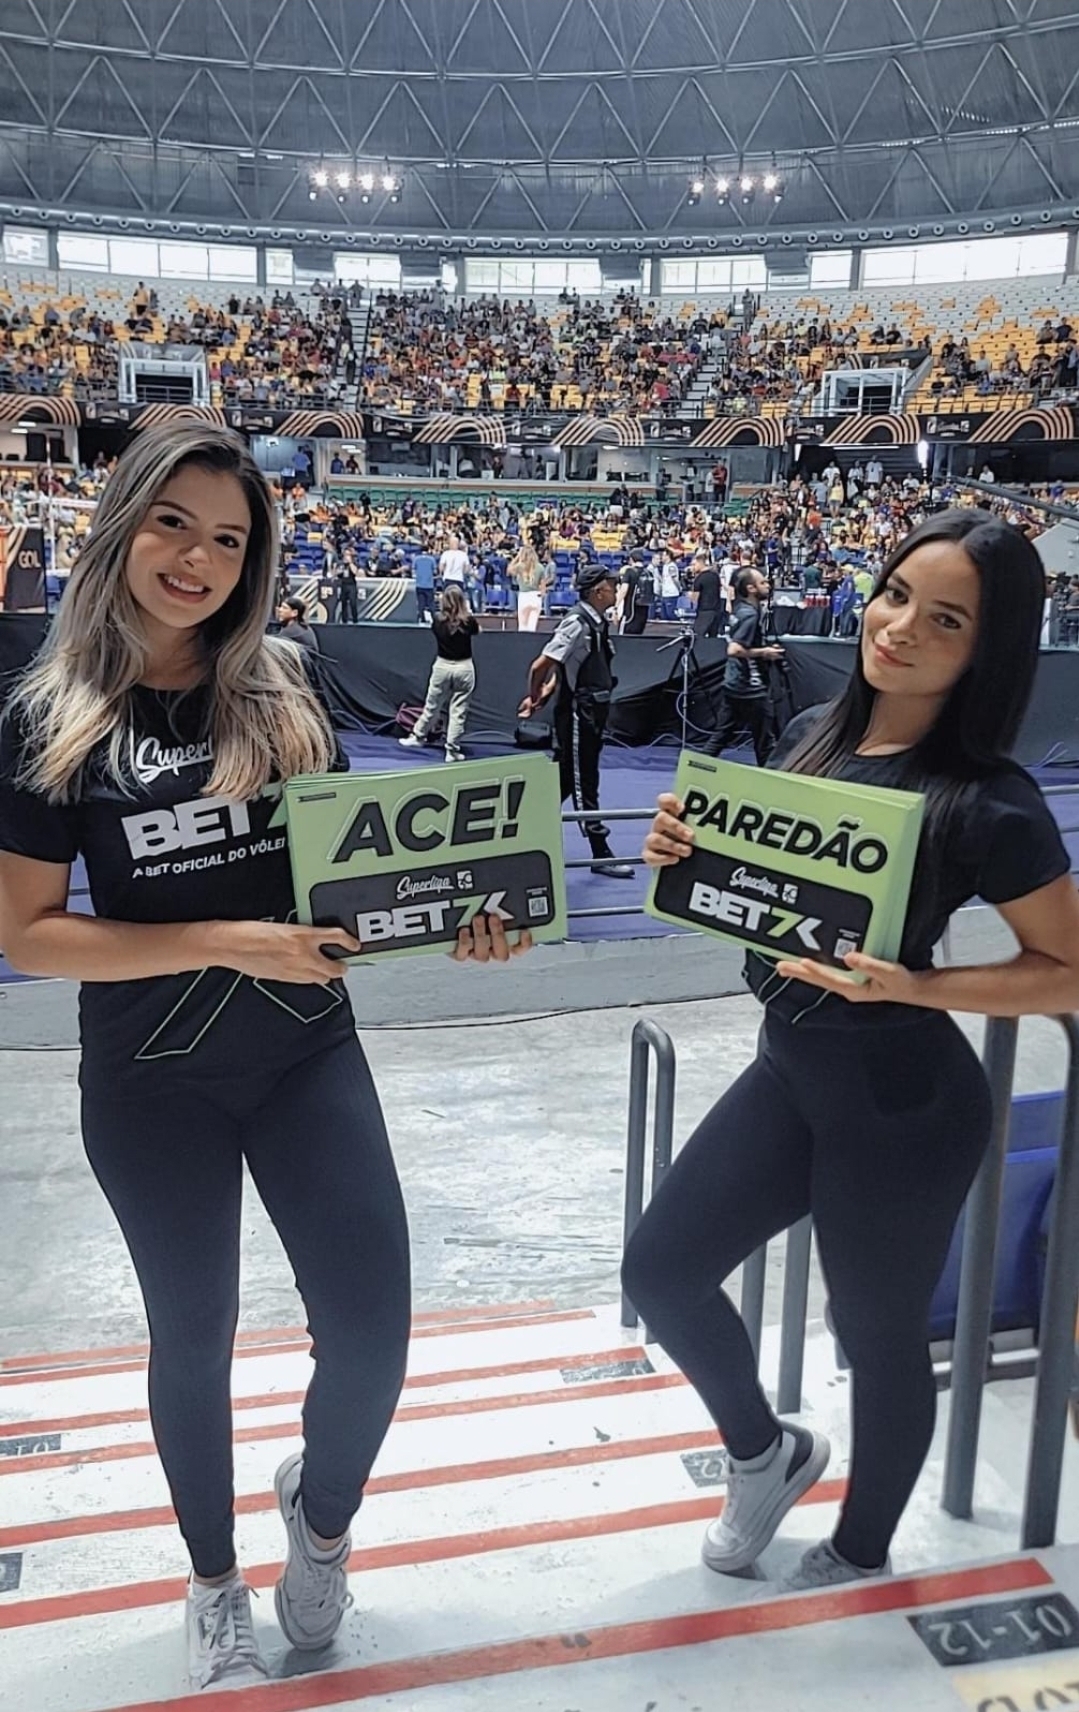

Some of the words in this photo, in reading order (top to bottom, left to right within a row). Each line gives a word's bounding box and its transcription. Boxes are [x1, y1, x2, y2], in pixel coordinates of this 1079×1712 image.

[329, 778, 526, 863] ACE!
[680, 787, 889, 874] PAREDÃO
[132, 867, 144, 879] A
[145, 863, 171, 877] BET
[172, 853, 225, 874] OFICIAL
[228, 847, 247, 862] DO
[250, 837, 286, 856] VÔLEI
[356, 891, 515, 943] BET7K
[688, 881, 823, 951] BET7K
[928, 1604, 1073, 1656] 01-12
